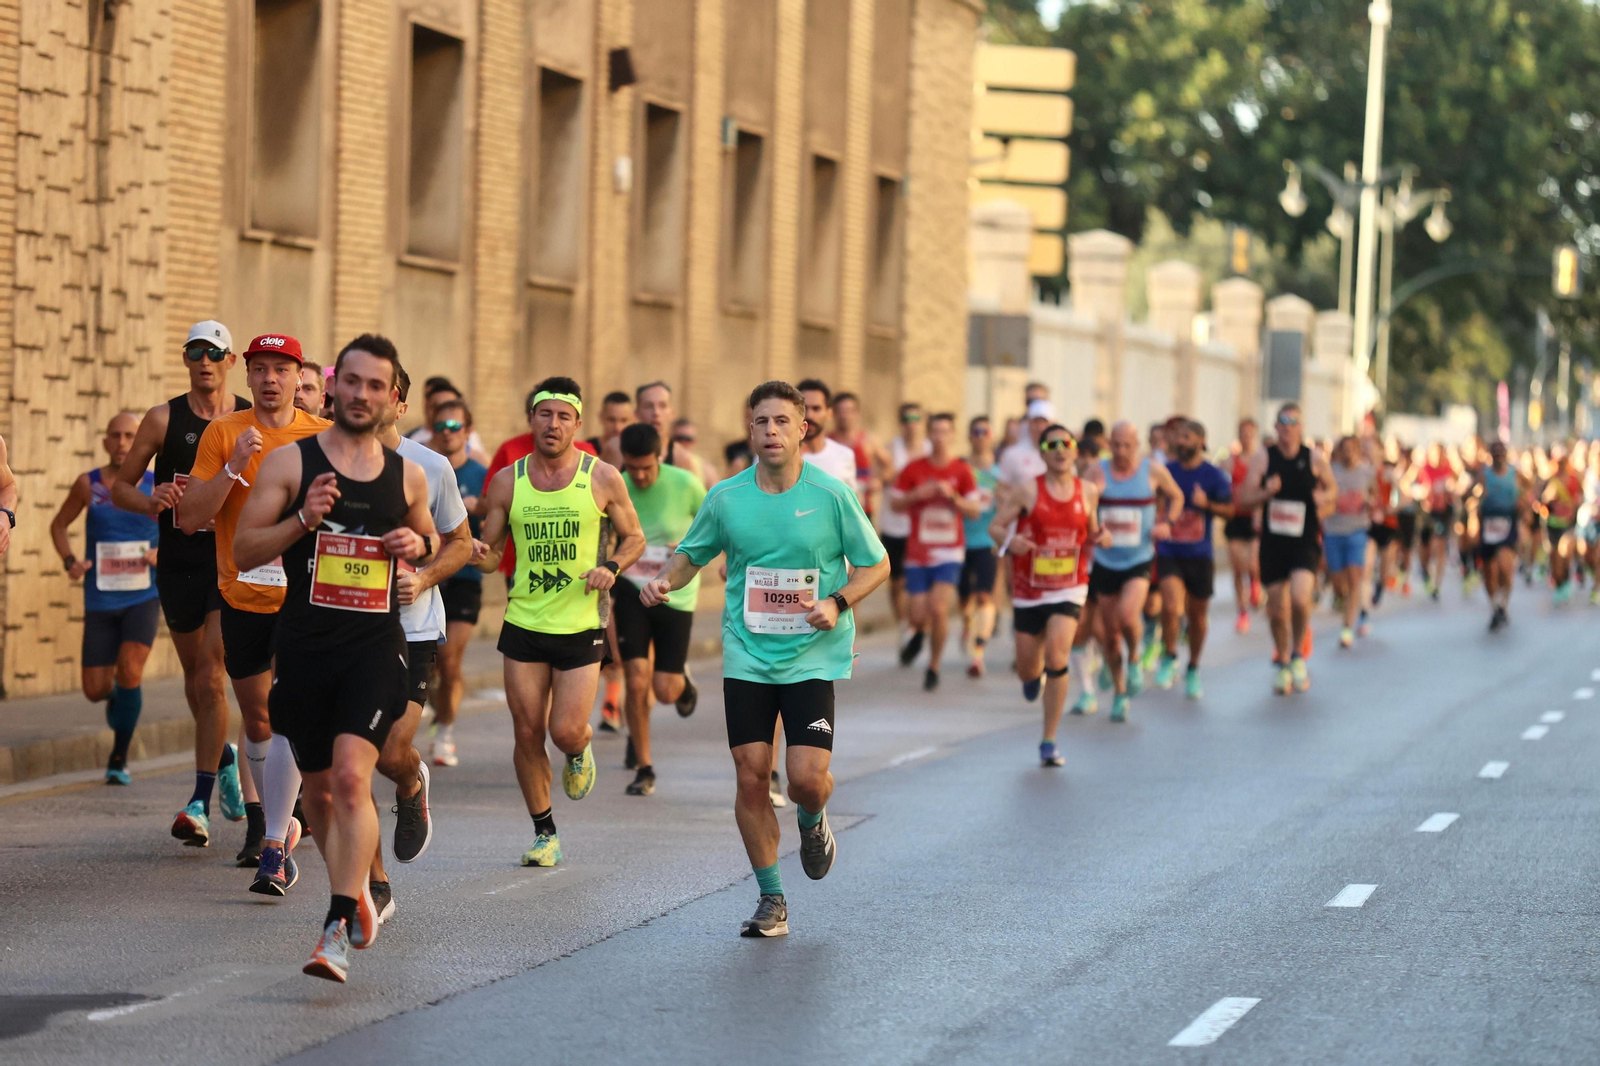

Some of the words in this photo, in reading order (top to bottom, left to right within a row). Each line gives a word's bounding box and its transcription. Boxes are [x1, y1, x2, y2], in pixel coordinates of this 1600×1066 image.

[523, 518, 580, 541] DUATLÓN
[528, 543, 577, 562] URBANO
[344, 562, 369, 576] 950
[763, 592, 800, 604] 10295
